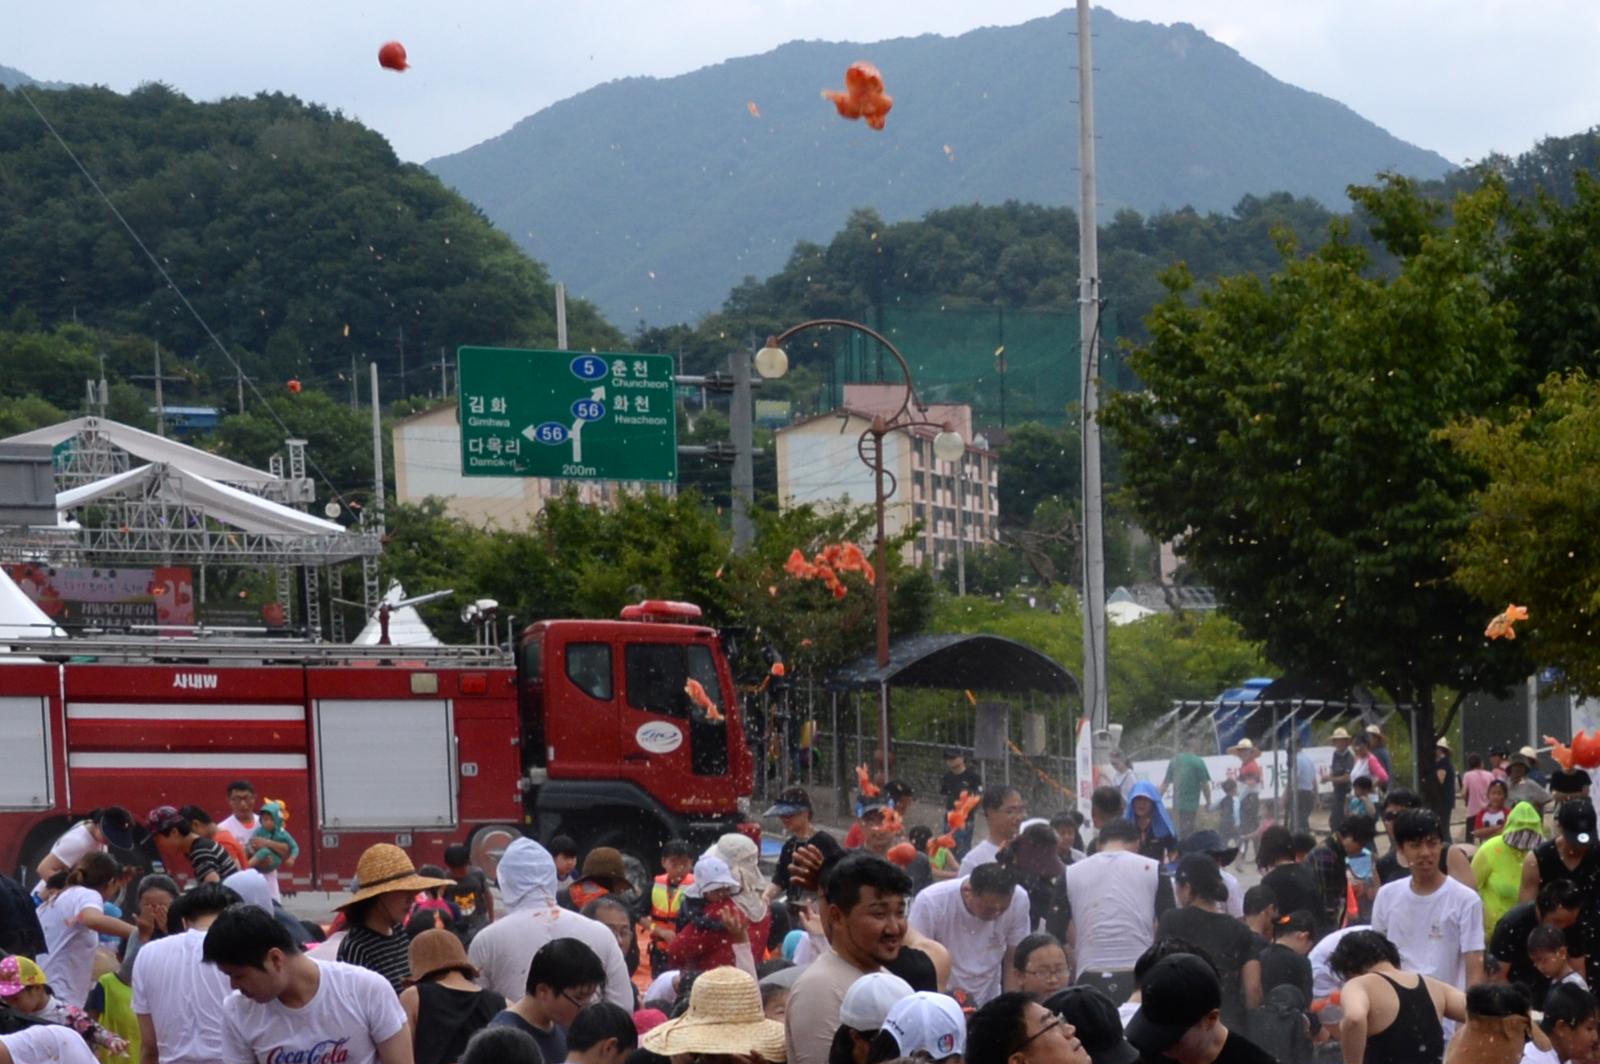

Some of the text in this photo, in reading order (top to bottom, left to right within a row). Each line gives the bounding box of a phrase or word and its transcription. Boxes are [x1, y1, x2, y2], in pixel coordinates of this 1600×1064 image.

[583, 360, 595, 375] 5
[611, 378, 668, 389] Chuncheon
[578, 403, 599, 417] 56
[468, 417, 510, 428] Gimhwa
[614, 414, 667, 426] Hwacheon
[542, 427, 562, 441] 56
[469, 437, 520, 455] 다목리
[469, 456, 516, 467] Damok-ri
[562, 464, 596, 476] 200m
[81, 602, 155, 616] HWACHEON
